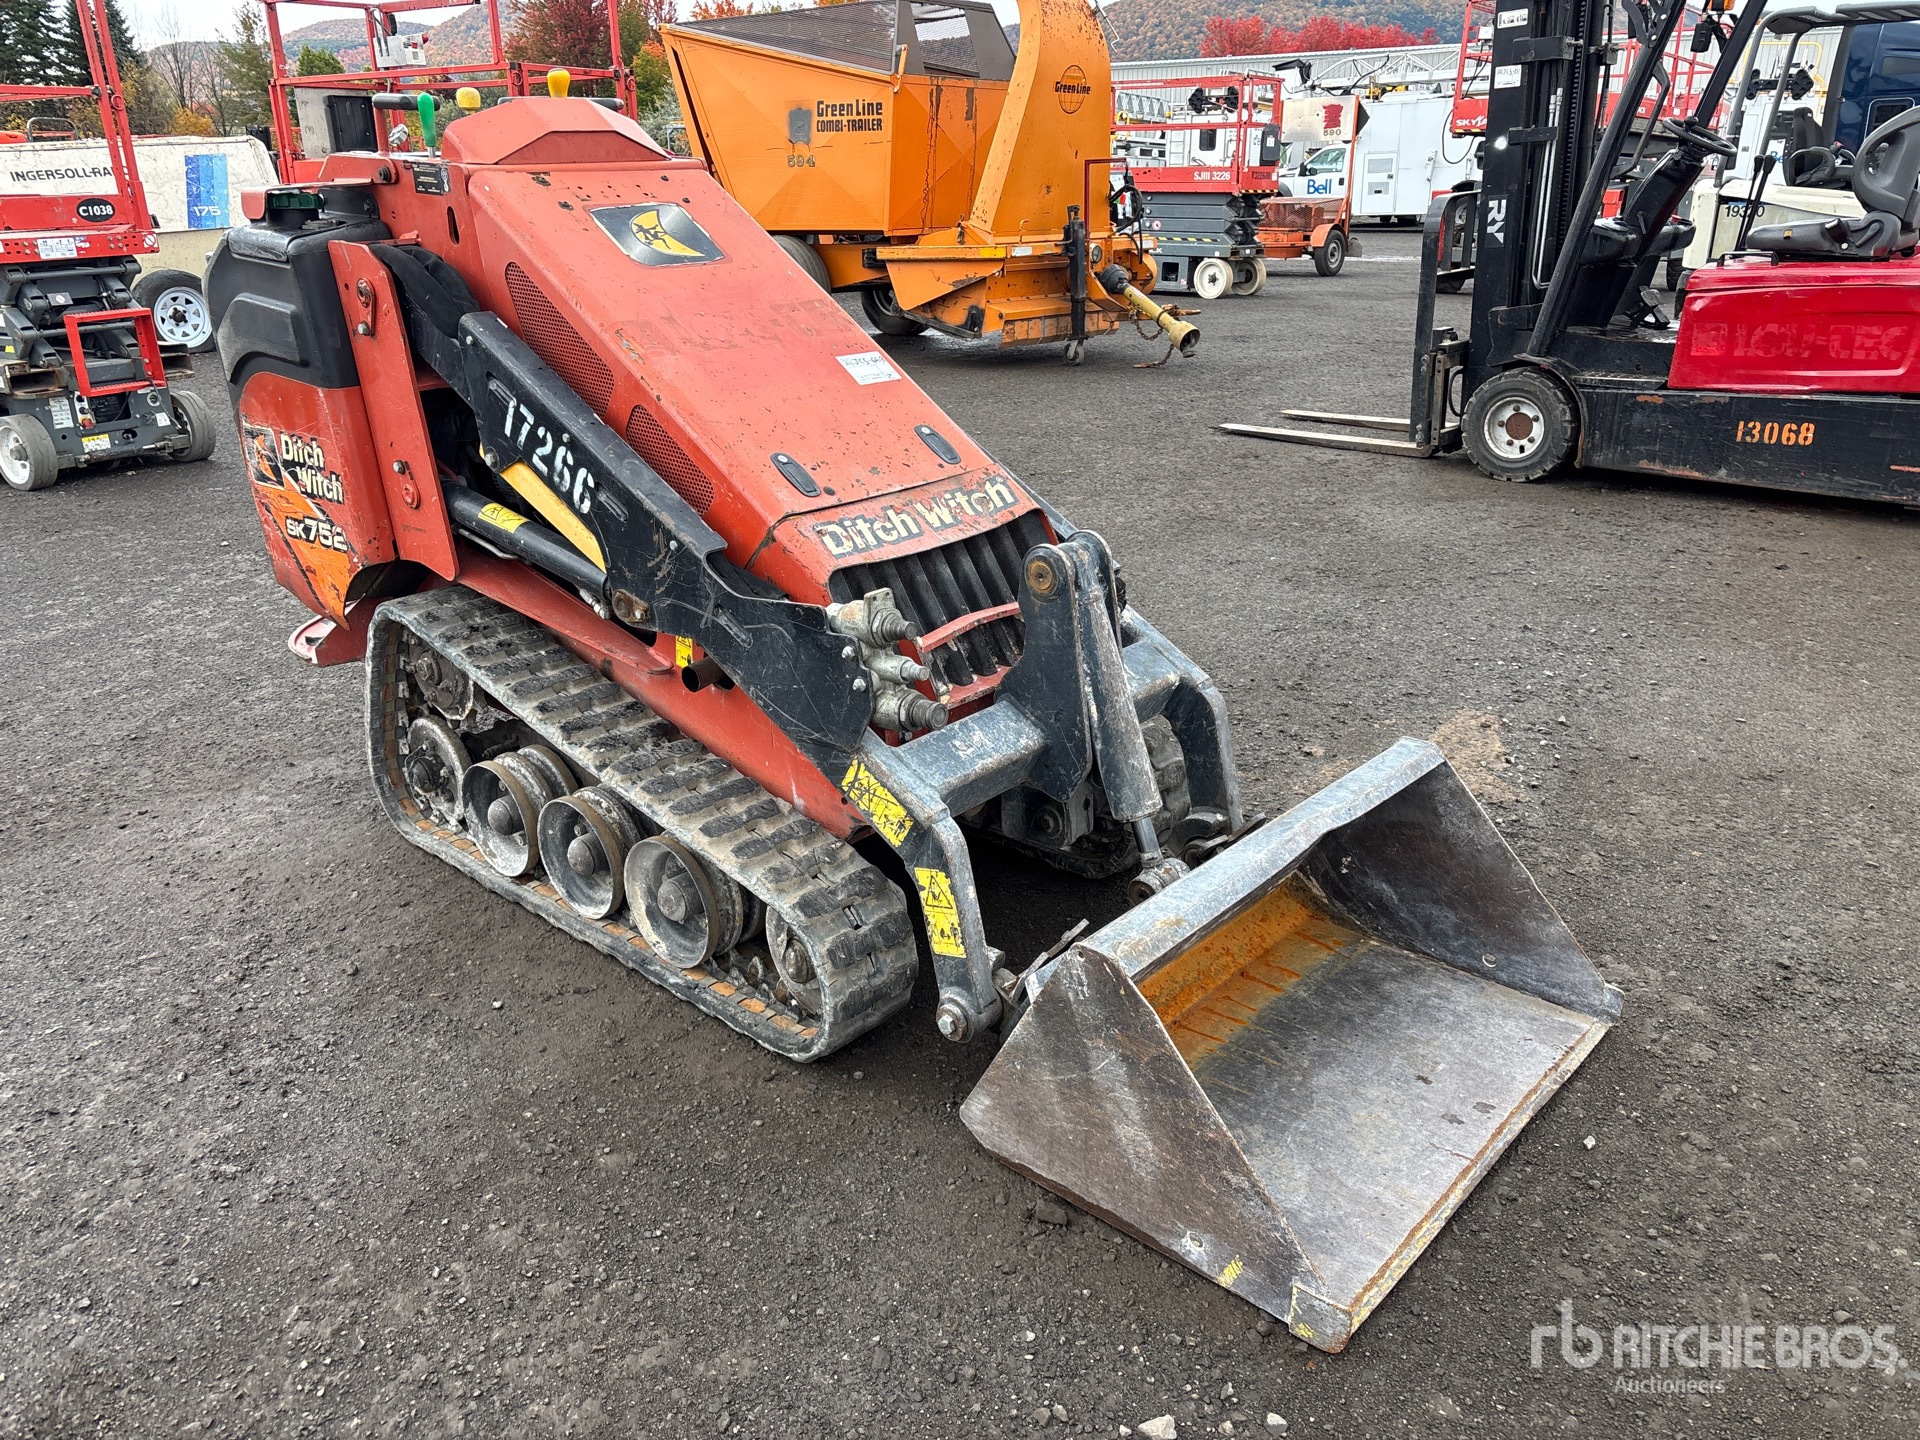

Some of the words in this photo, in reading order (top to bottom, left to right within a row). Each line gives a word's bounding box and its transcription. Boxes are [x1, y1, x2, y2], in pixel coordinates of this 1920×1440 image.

[817, 100, 853, 117] Green
[856, 99, 883, 116] Line
[817, 118, 882, 132] COMBI-TRAILER
[1212, 172, 1230, 180] 3226
[1307, 179, 1332, 194] Bell
[78, 205, 114, 217] C1038
[194, 205, 222, 216] 175
[1736, 420, 1815, 446] 13068
[280, 432, 325, 468] Ditch
[504, 398, 595, 514] 17266
[296, 466, 344, 501] Witch
[820, 508, 920, 556] Ditch
[913, 480, 1018, 528] Witch
[285, 518, 349, 551] SK752
